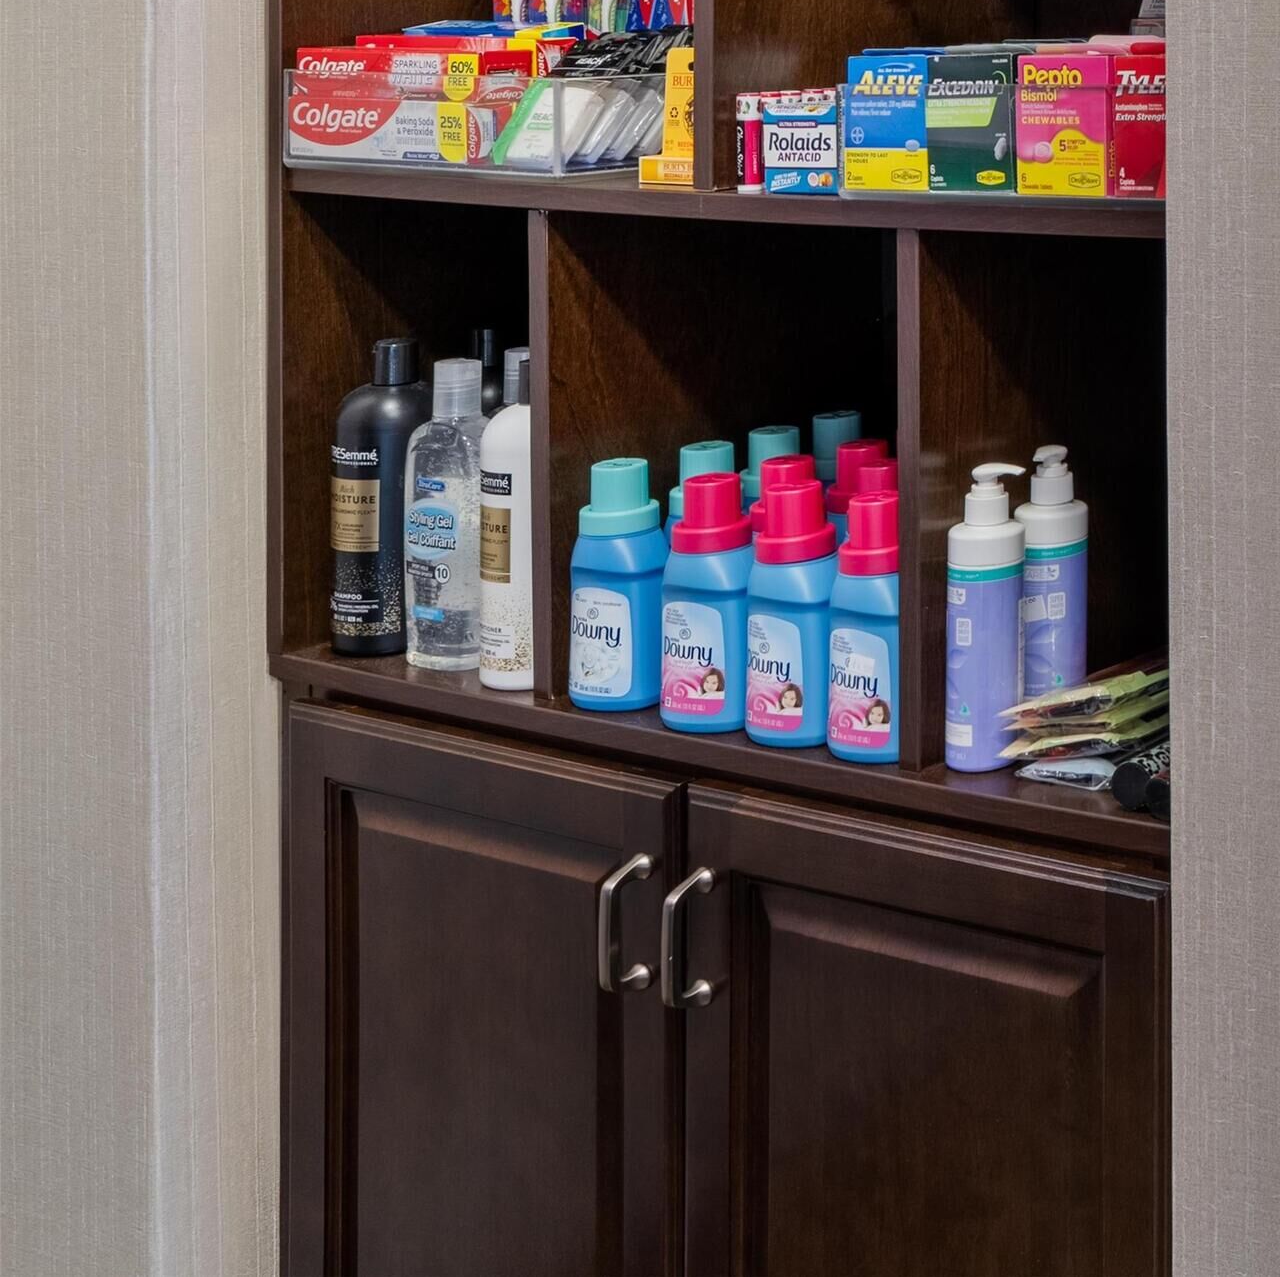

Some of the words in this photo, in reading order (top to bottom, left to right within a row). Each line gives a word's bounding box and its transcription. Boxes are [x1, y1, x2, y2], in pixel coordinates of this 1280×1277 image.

[394, 60, 437, 69] SPARKLING
[575, 56, 603, 65] REACH
[297, 56, 364, 78] Colgate
[450, 61, 473, 74] 60%
[448, 77, 467, 86] FREE
[1023, 64, 1082, 88] Pepto
[852, 70, 923, 95] ALEVE
[927, 78, 996, 96] EXCEDRIN
[1116, 70, 1166, 97] TYLE
[1021, 90, 1057, 102] Bismol
[293, 102, 378, 132] Colgate
[395, 116, 417, 127] Baking
[418, 116, 434, 126] Soda
[440, 116, 462, 128] 25%
[1021, 116, 1080, 124] CHEWABLES
[402, 127, 433, 136] Peroxide
[443, 132, 461, 141] FREE
[769, 132, 831, 151] Rolaids
[1060, 140, 1066, 152] 5
[778, 153, 821, 162] ANTACID
[930, 164, 935, 174] 6
[1119, 167, 1125, 178] 4
[847, 172, 852, 180] 2
[409, 510, 435, 530] Styling
[436, 513, 453, 529] Gel
[408, 530, 420, 544] Gel
[420, 531, 455, 550] Coiffant
[437, 567, 448, 580] 10
[573, 616, 621, 648] Downy
[664, 636, 713, 668] Downy
[830, 664, 878, 698] Downy
